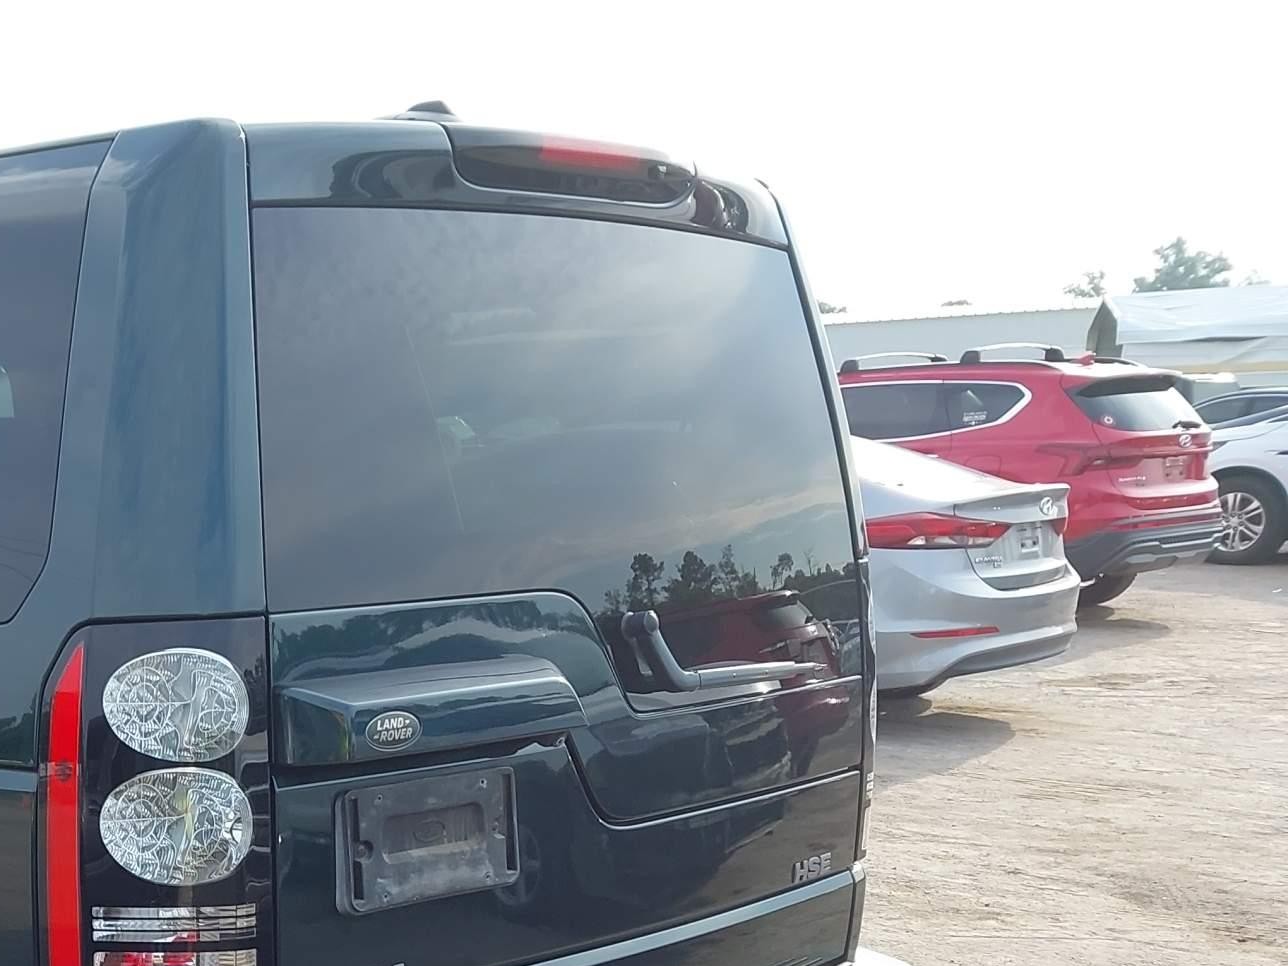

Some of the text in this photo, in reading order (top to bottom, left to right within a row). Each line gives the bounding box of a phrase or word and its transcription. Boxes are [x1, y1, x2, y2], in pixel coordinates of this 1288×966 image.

[376, 717, 404, 731] LAND
[379, 727, 413, 742] ROVER
[791, 851, 832, 885] HSE
